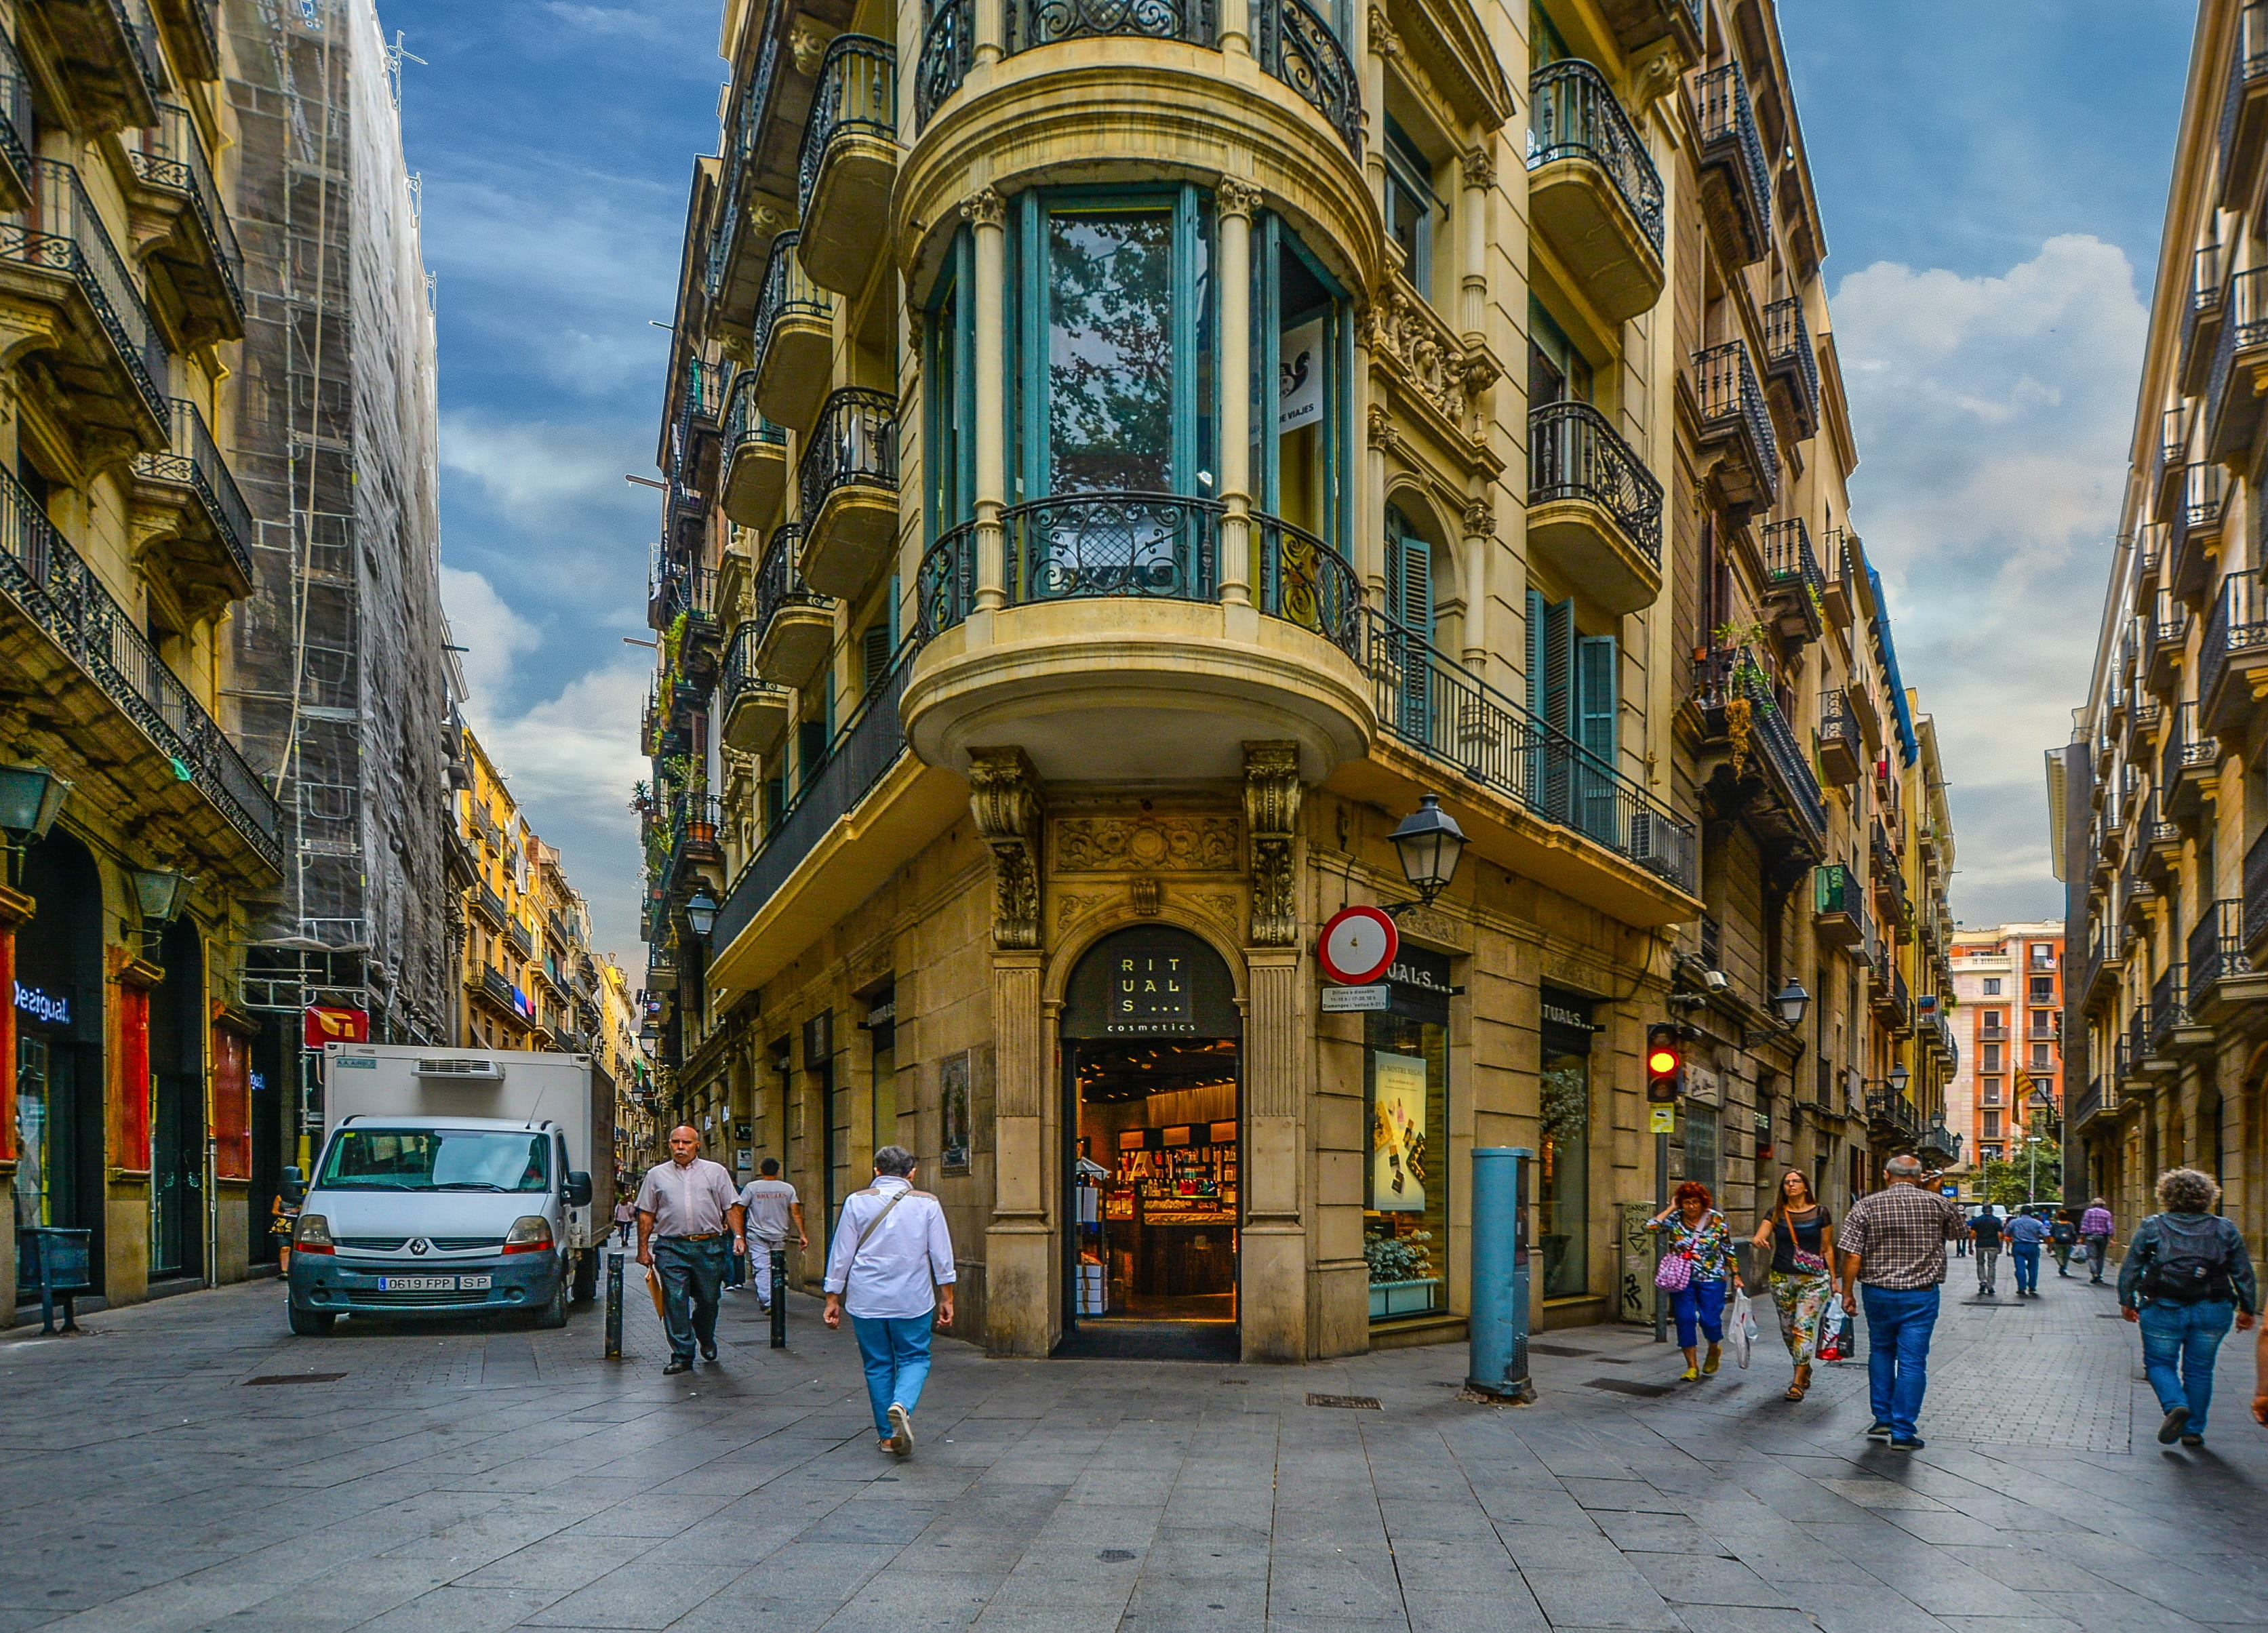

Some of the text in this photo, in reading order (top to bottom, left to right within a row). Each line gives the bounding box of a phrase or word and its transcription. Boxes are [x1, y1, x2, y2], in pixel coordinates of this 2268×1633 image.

[1288, 403, 1314, 420] VIAJES
[1107, 1023, 1195, 1032] cosmetics
[389, 1279, 422, 1289] 0619
[426, 1278, 450, 1288] FPP
